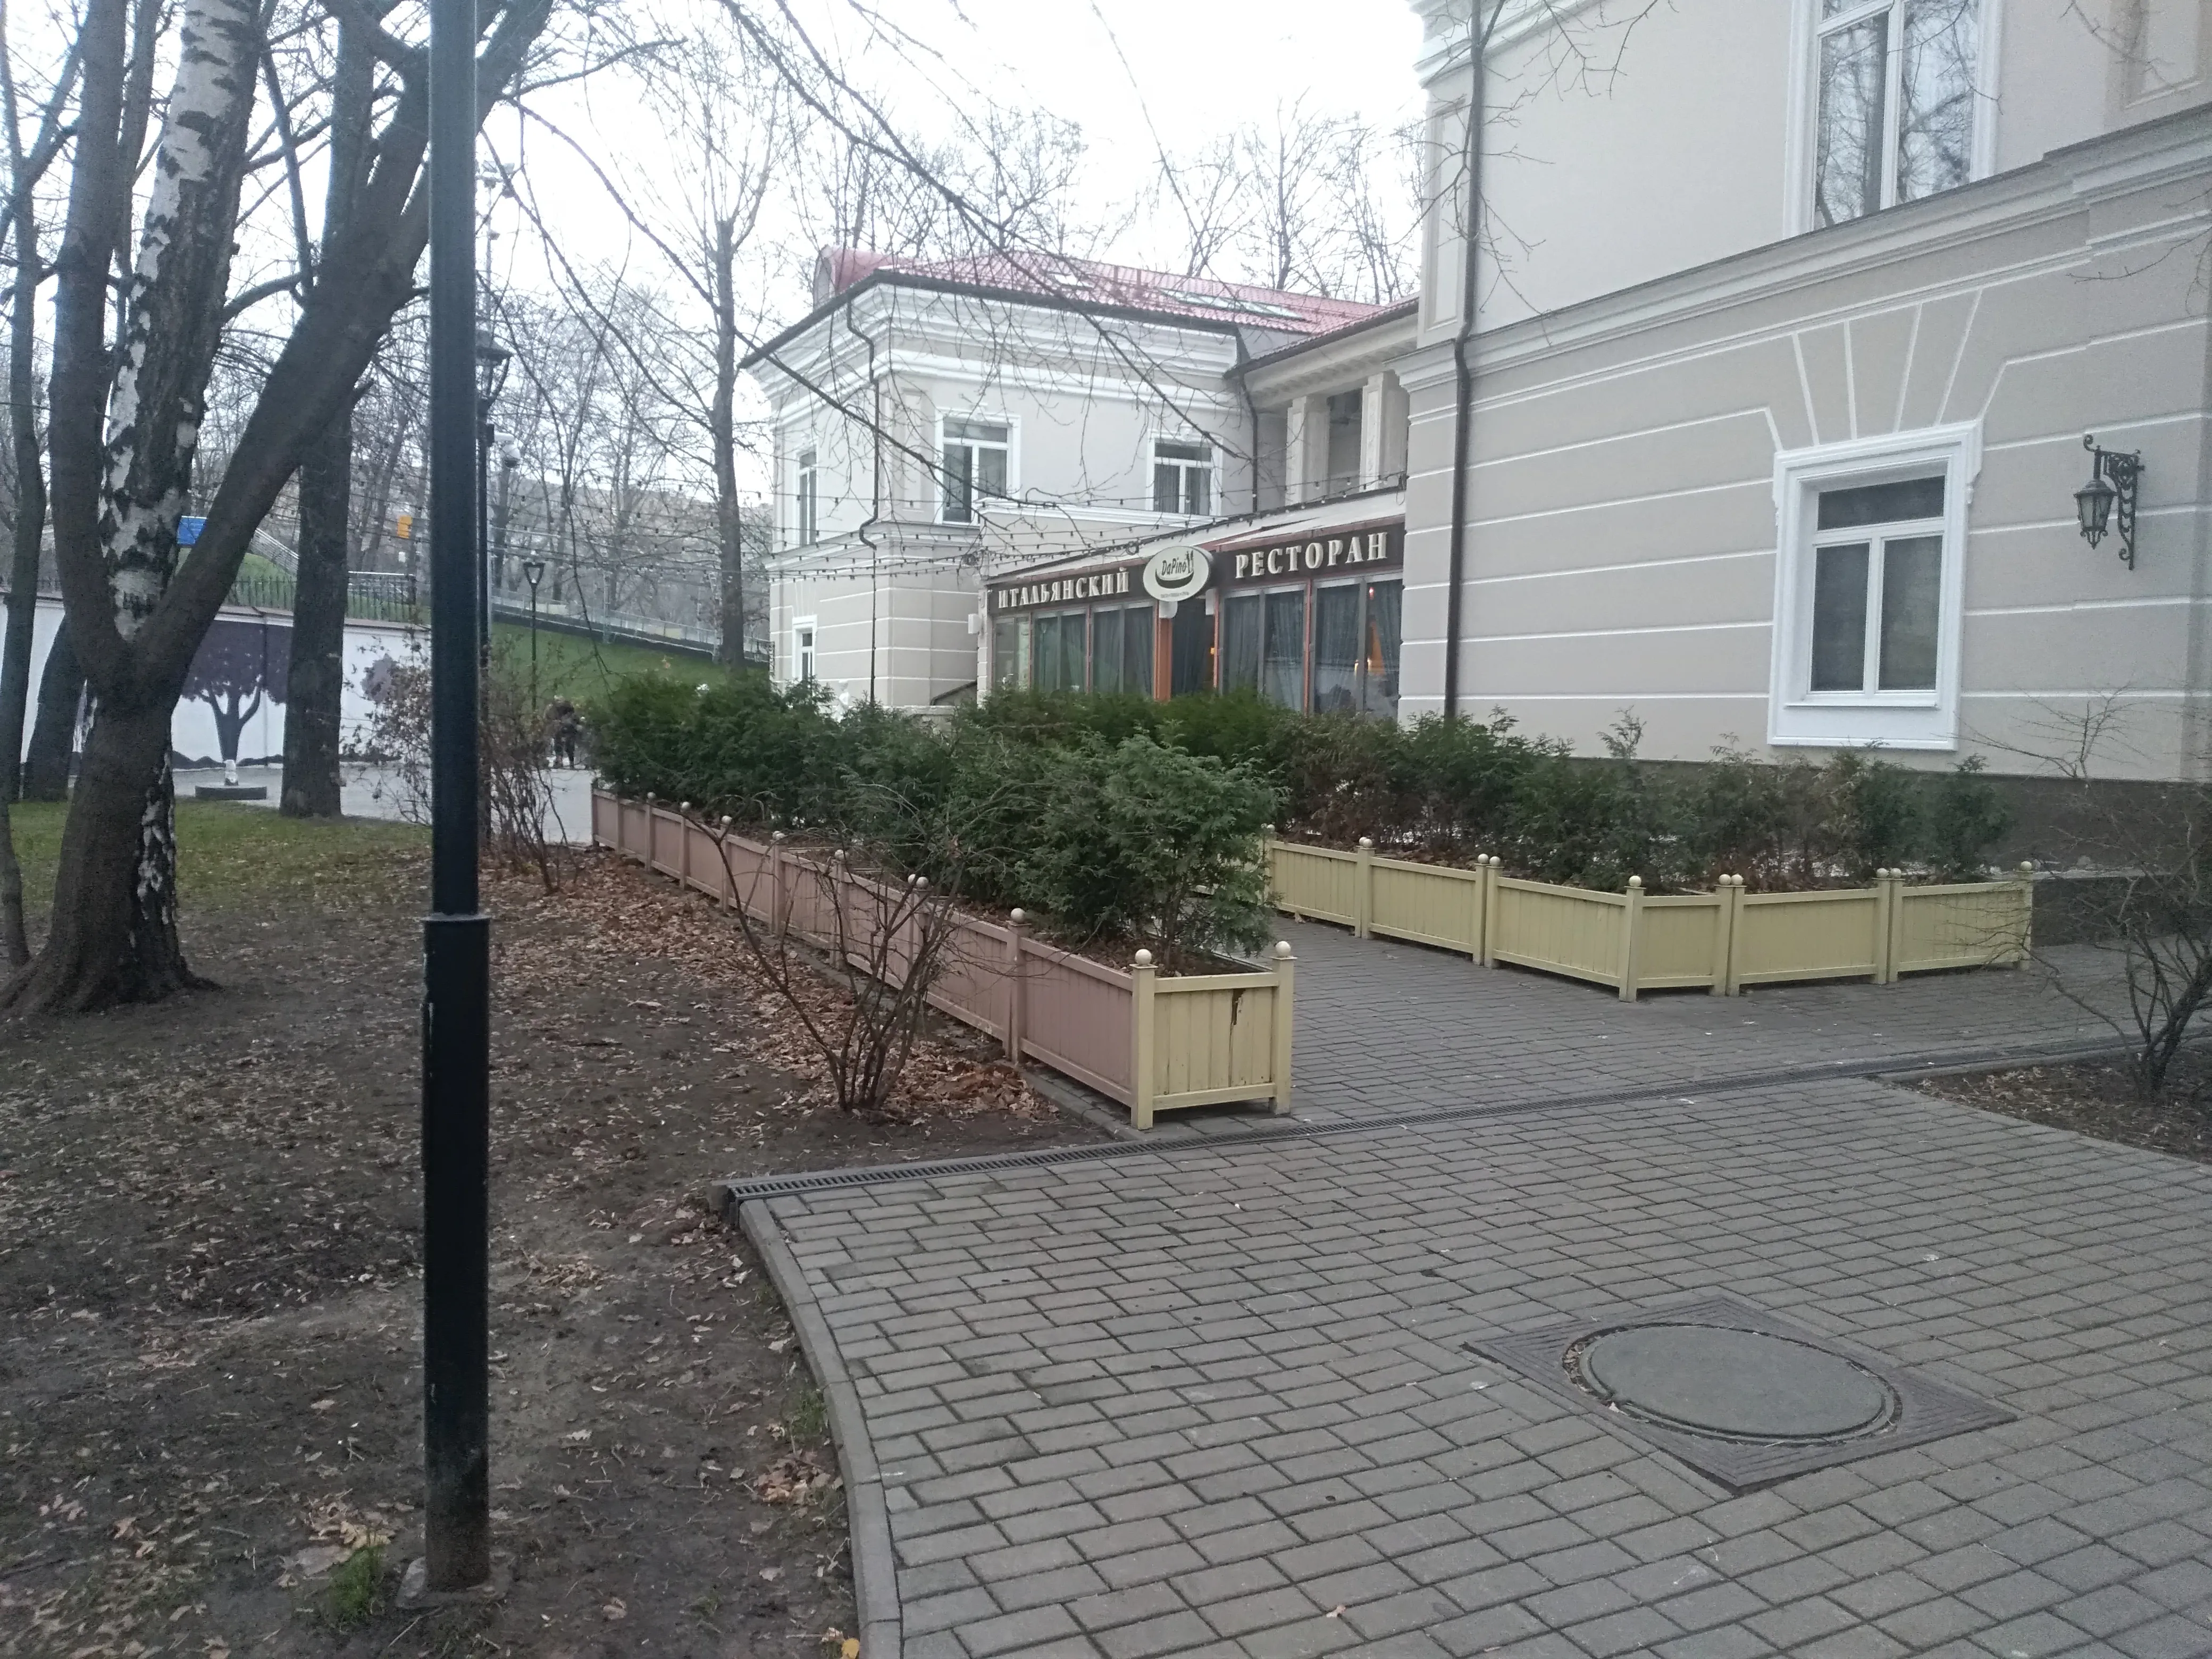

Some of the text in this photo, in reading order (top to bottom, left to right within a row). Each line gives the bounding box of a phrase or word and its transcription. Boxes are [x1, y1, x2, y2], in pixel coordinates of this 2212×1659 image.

[998, 532, 1388, 608] ИТАЛЬЯНСКИЙ РЕСТОРАН
[1162, 557, 1187, 576] DaPino
